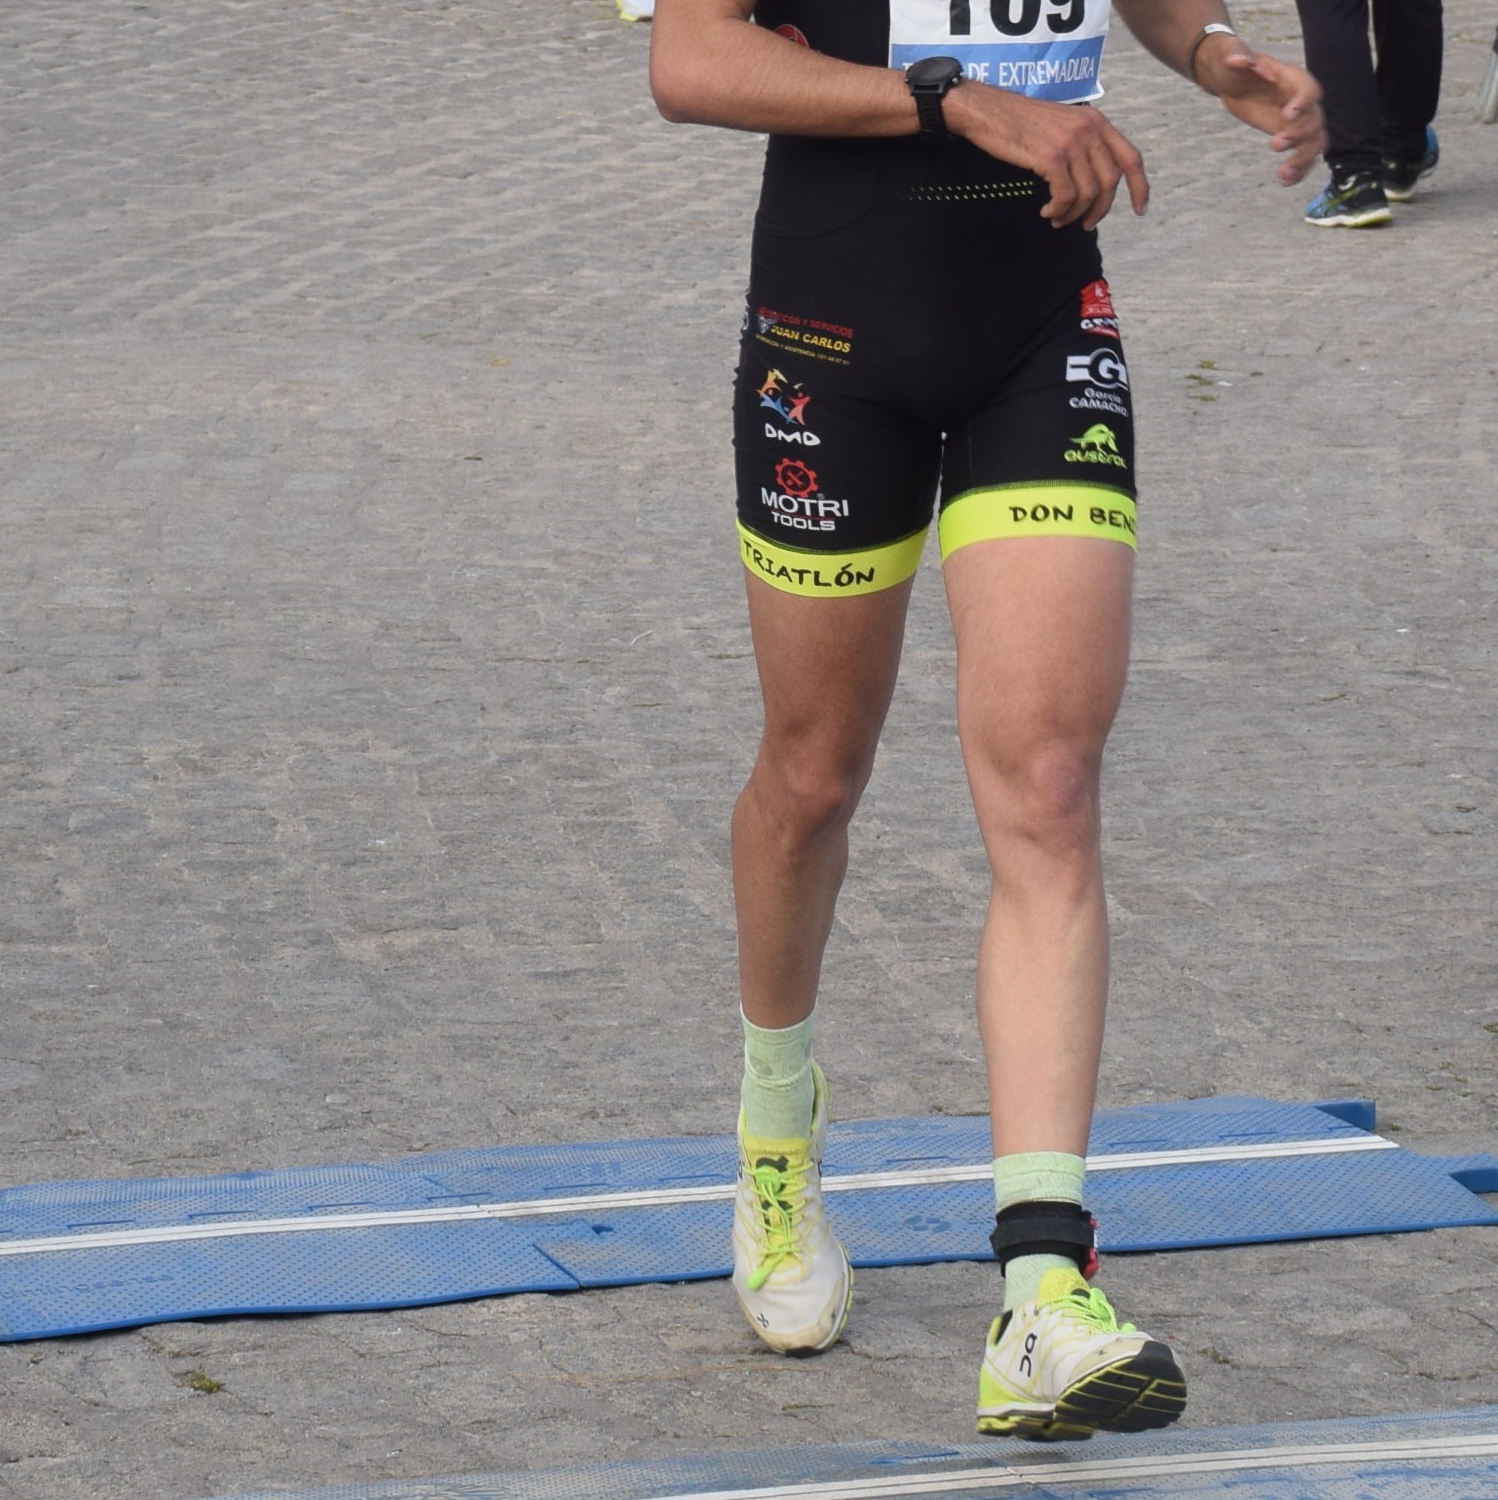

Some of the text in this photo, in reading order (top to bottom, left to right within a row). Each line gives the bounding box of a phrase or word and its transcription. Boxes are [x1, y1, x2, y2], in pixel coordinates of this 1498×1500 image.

[968, 56, 1095, 87] DE EXTREMADURA
[770, 325, 800, 341] JUAN
[802, 333, 852, 354] CARLOS
[764, 422, 822, 447] DMD
[760, 486, 850, 519] MOTRI
[1007, 503, 1074, 525] DON
[771, 510, 837, 533] TOOLS
[743, 539, 876, 589] TRIATLÓN
